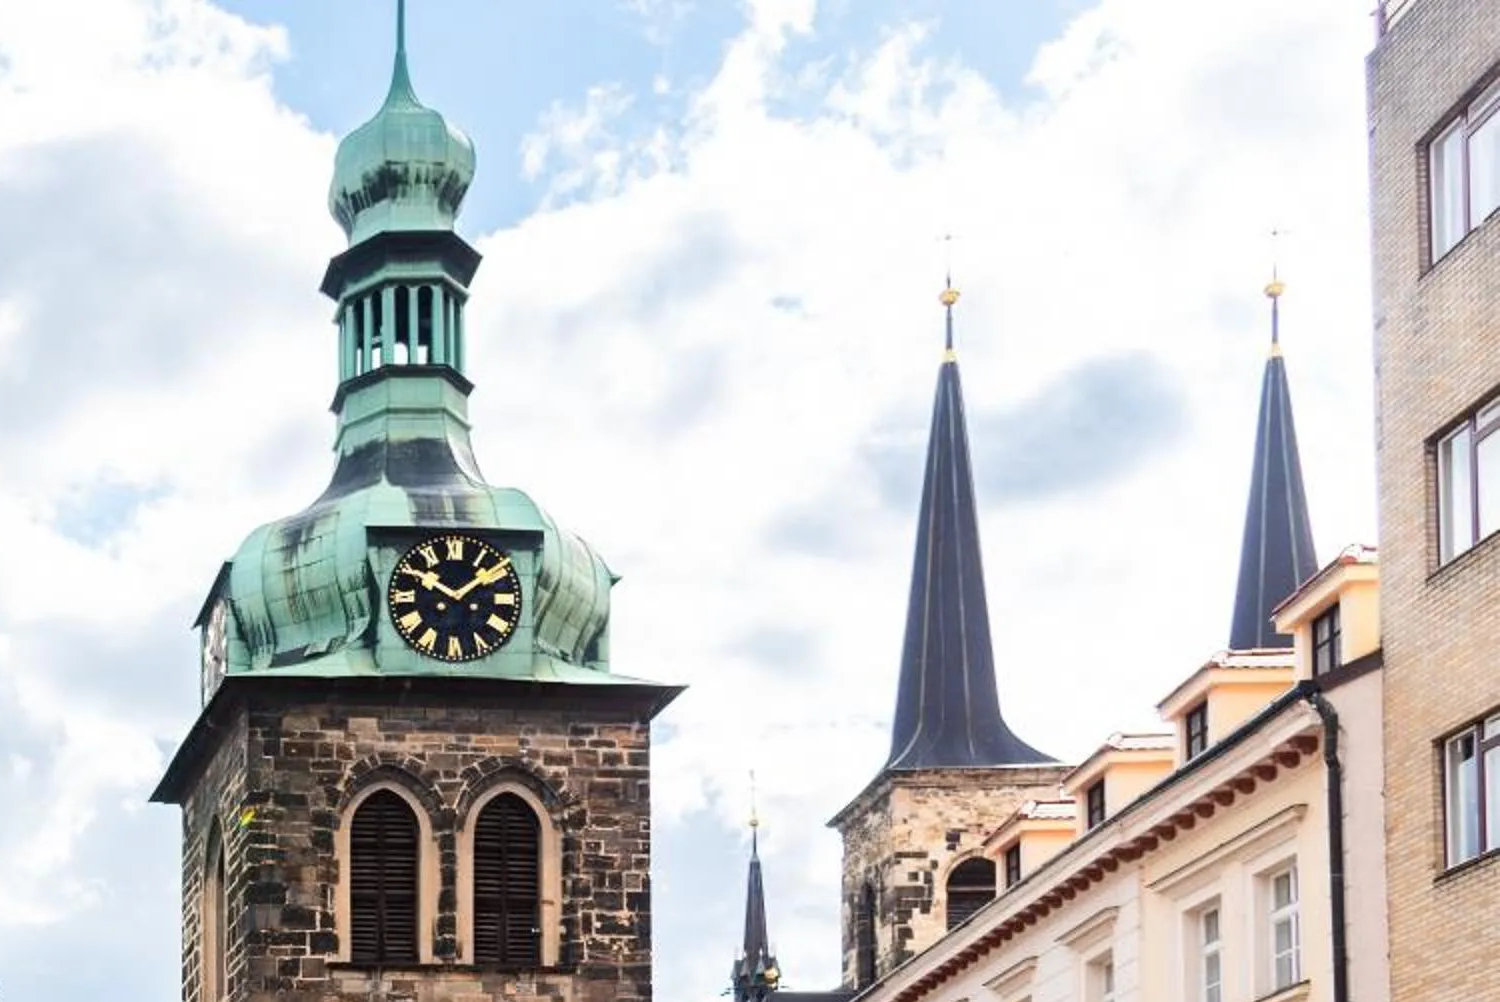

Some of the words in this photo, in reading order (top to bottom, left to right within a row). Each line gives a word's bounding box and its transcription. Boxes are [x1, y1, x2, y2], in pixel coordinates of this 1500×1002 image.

[420, 546, 440, 568] XI
[446, 538, 463, 560] XII
[473, 549, 487, 567] I
[394, 590, 415, 603] IX
[473, 632, 489, 656] V
